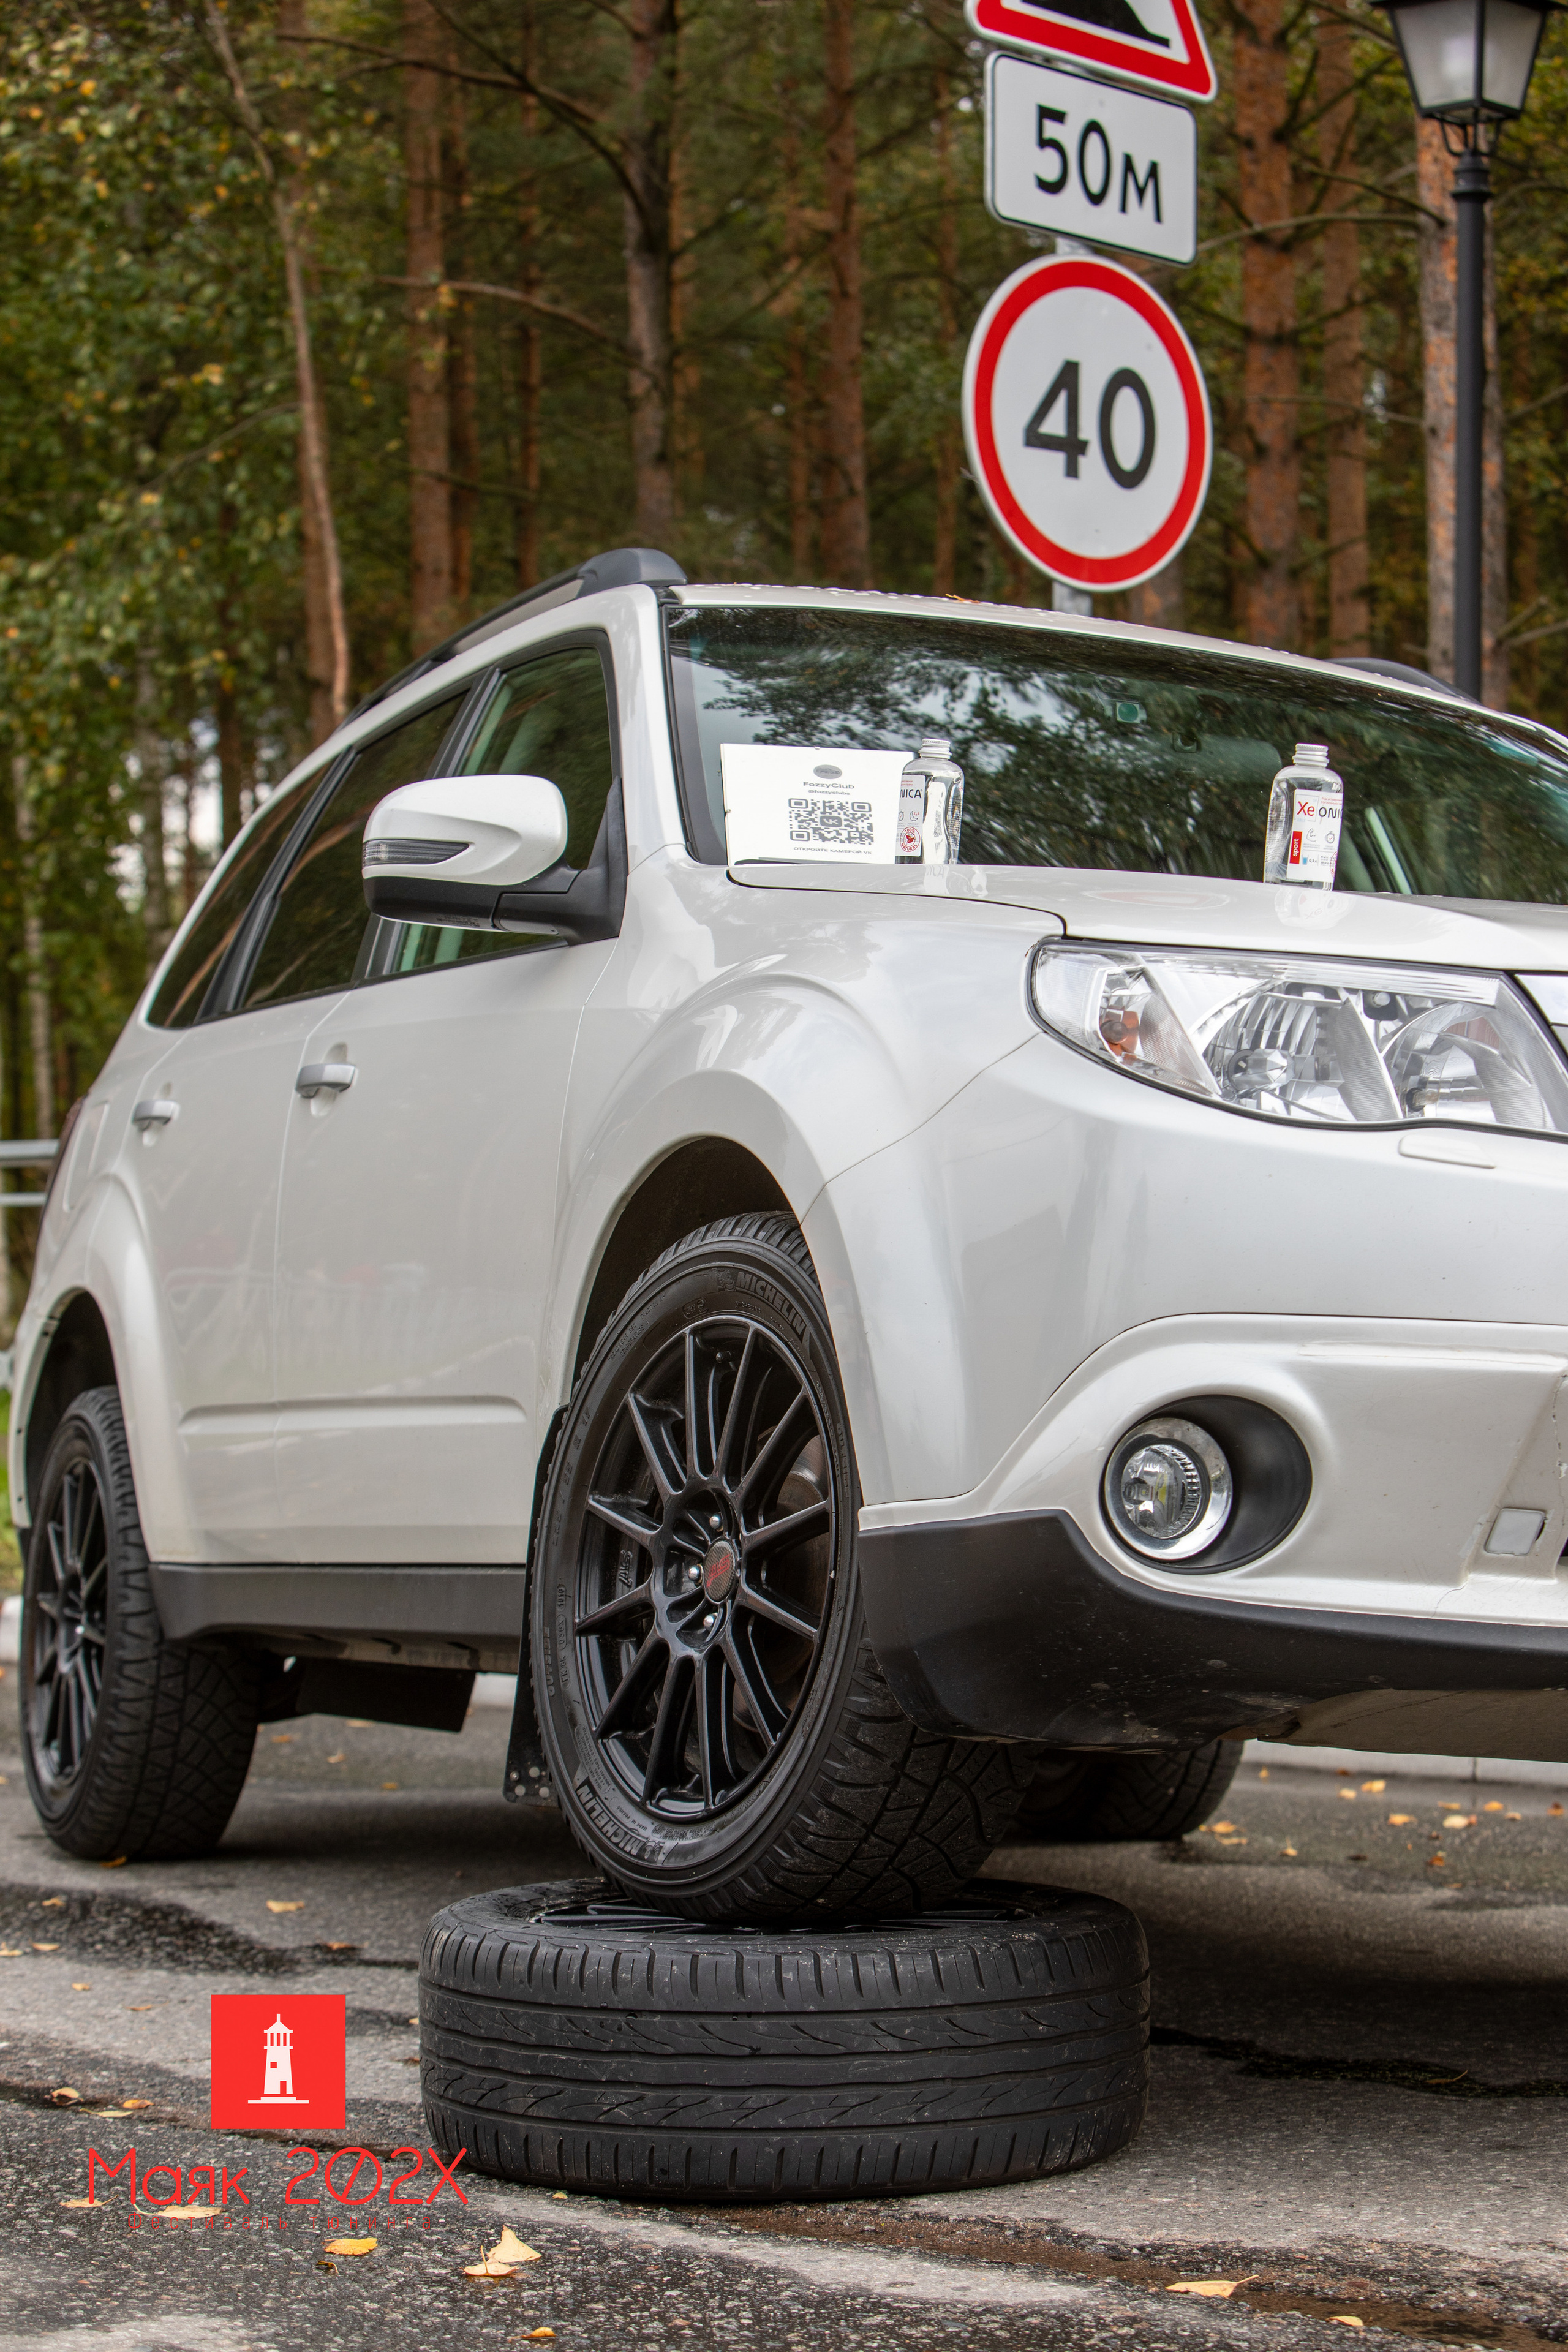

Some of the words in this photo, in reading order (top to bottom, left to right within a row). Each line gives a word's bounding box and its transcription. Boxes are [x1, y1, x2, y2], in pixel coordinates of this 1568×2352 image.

[1022, 358, 1156, 490] 40
[1297, 801, 1315, 816] Xe
[901, 842, 918, 851] NATURAL
[736, 1271, 807, 1335] MICHELIN
[543, 1626, 556, 1697] OUTSIDE
[575, 1784, 644, 1856] MICHELIN
[635, 1822, 647, 1831] MADE
